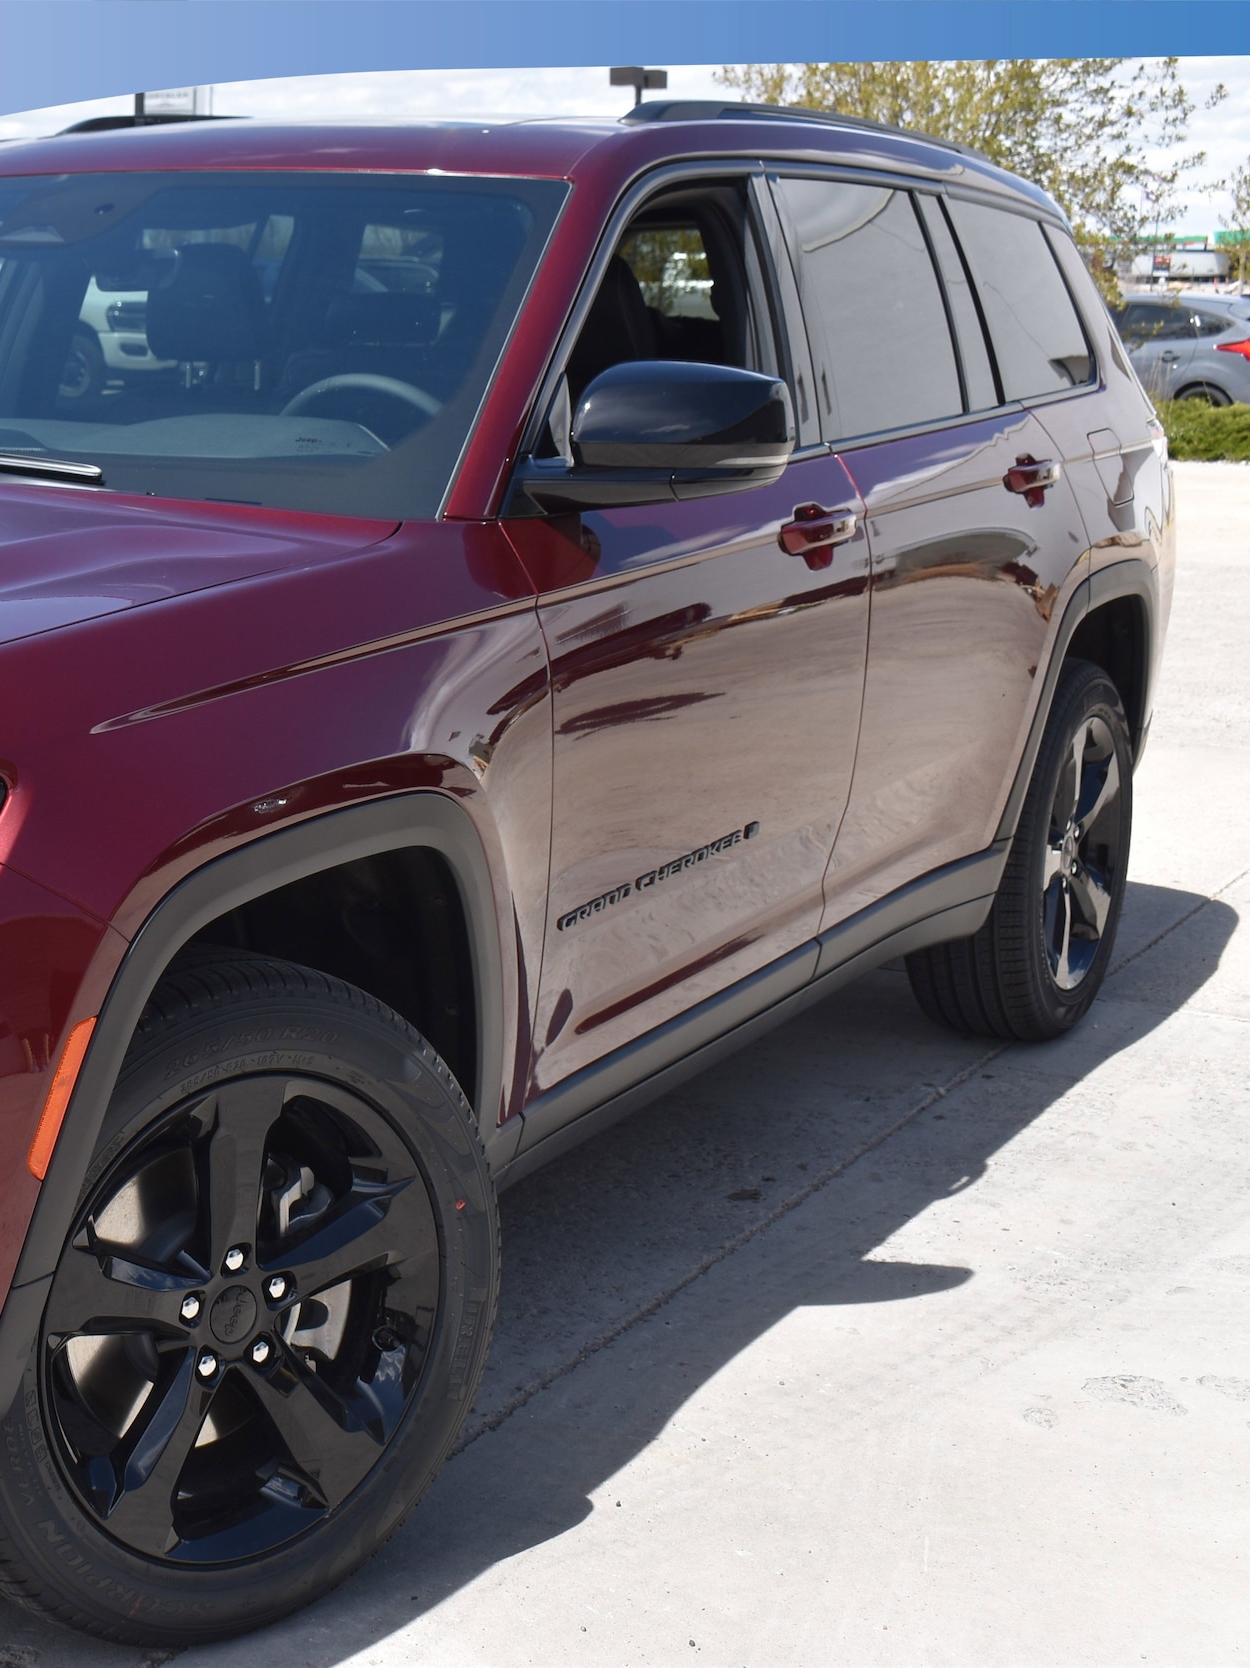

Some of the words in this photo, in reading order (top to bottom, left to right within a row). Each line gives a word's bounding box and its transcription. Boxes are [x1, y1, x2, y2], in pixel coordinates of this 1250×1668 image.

[556, 883, 634, 932] GRAND
[635, 829, 743, 891] CHEROKEE
[164, 1027, 273, 1082] 265/50
[279, 1024, 338, 1044] R20
[223, 1291, 248, 1337] Jeep
[3, 1417, 35, 1508] VERDE
[36, 1519, 215, 1618] SCORPION
